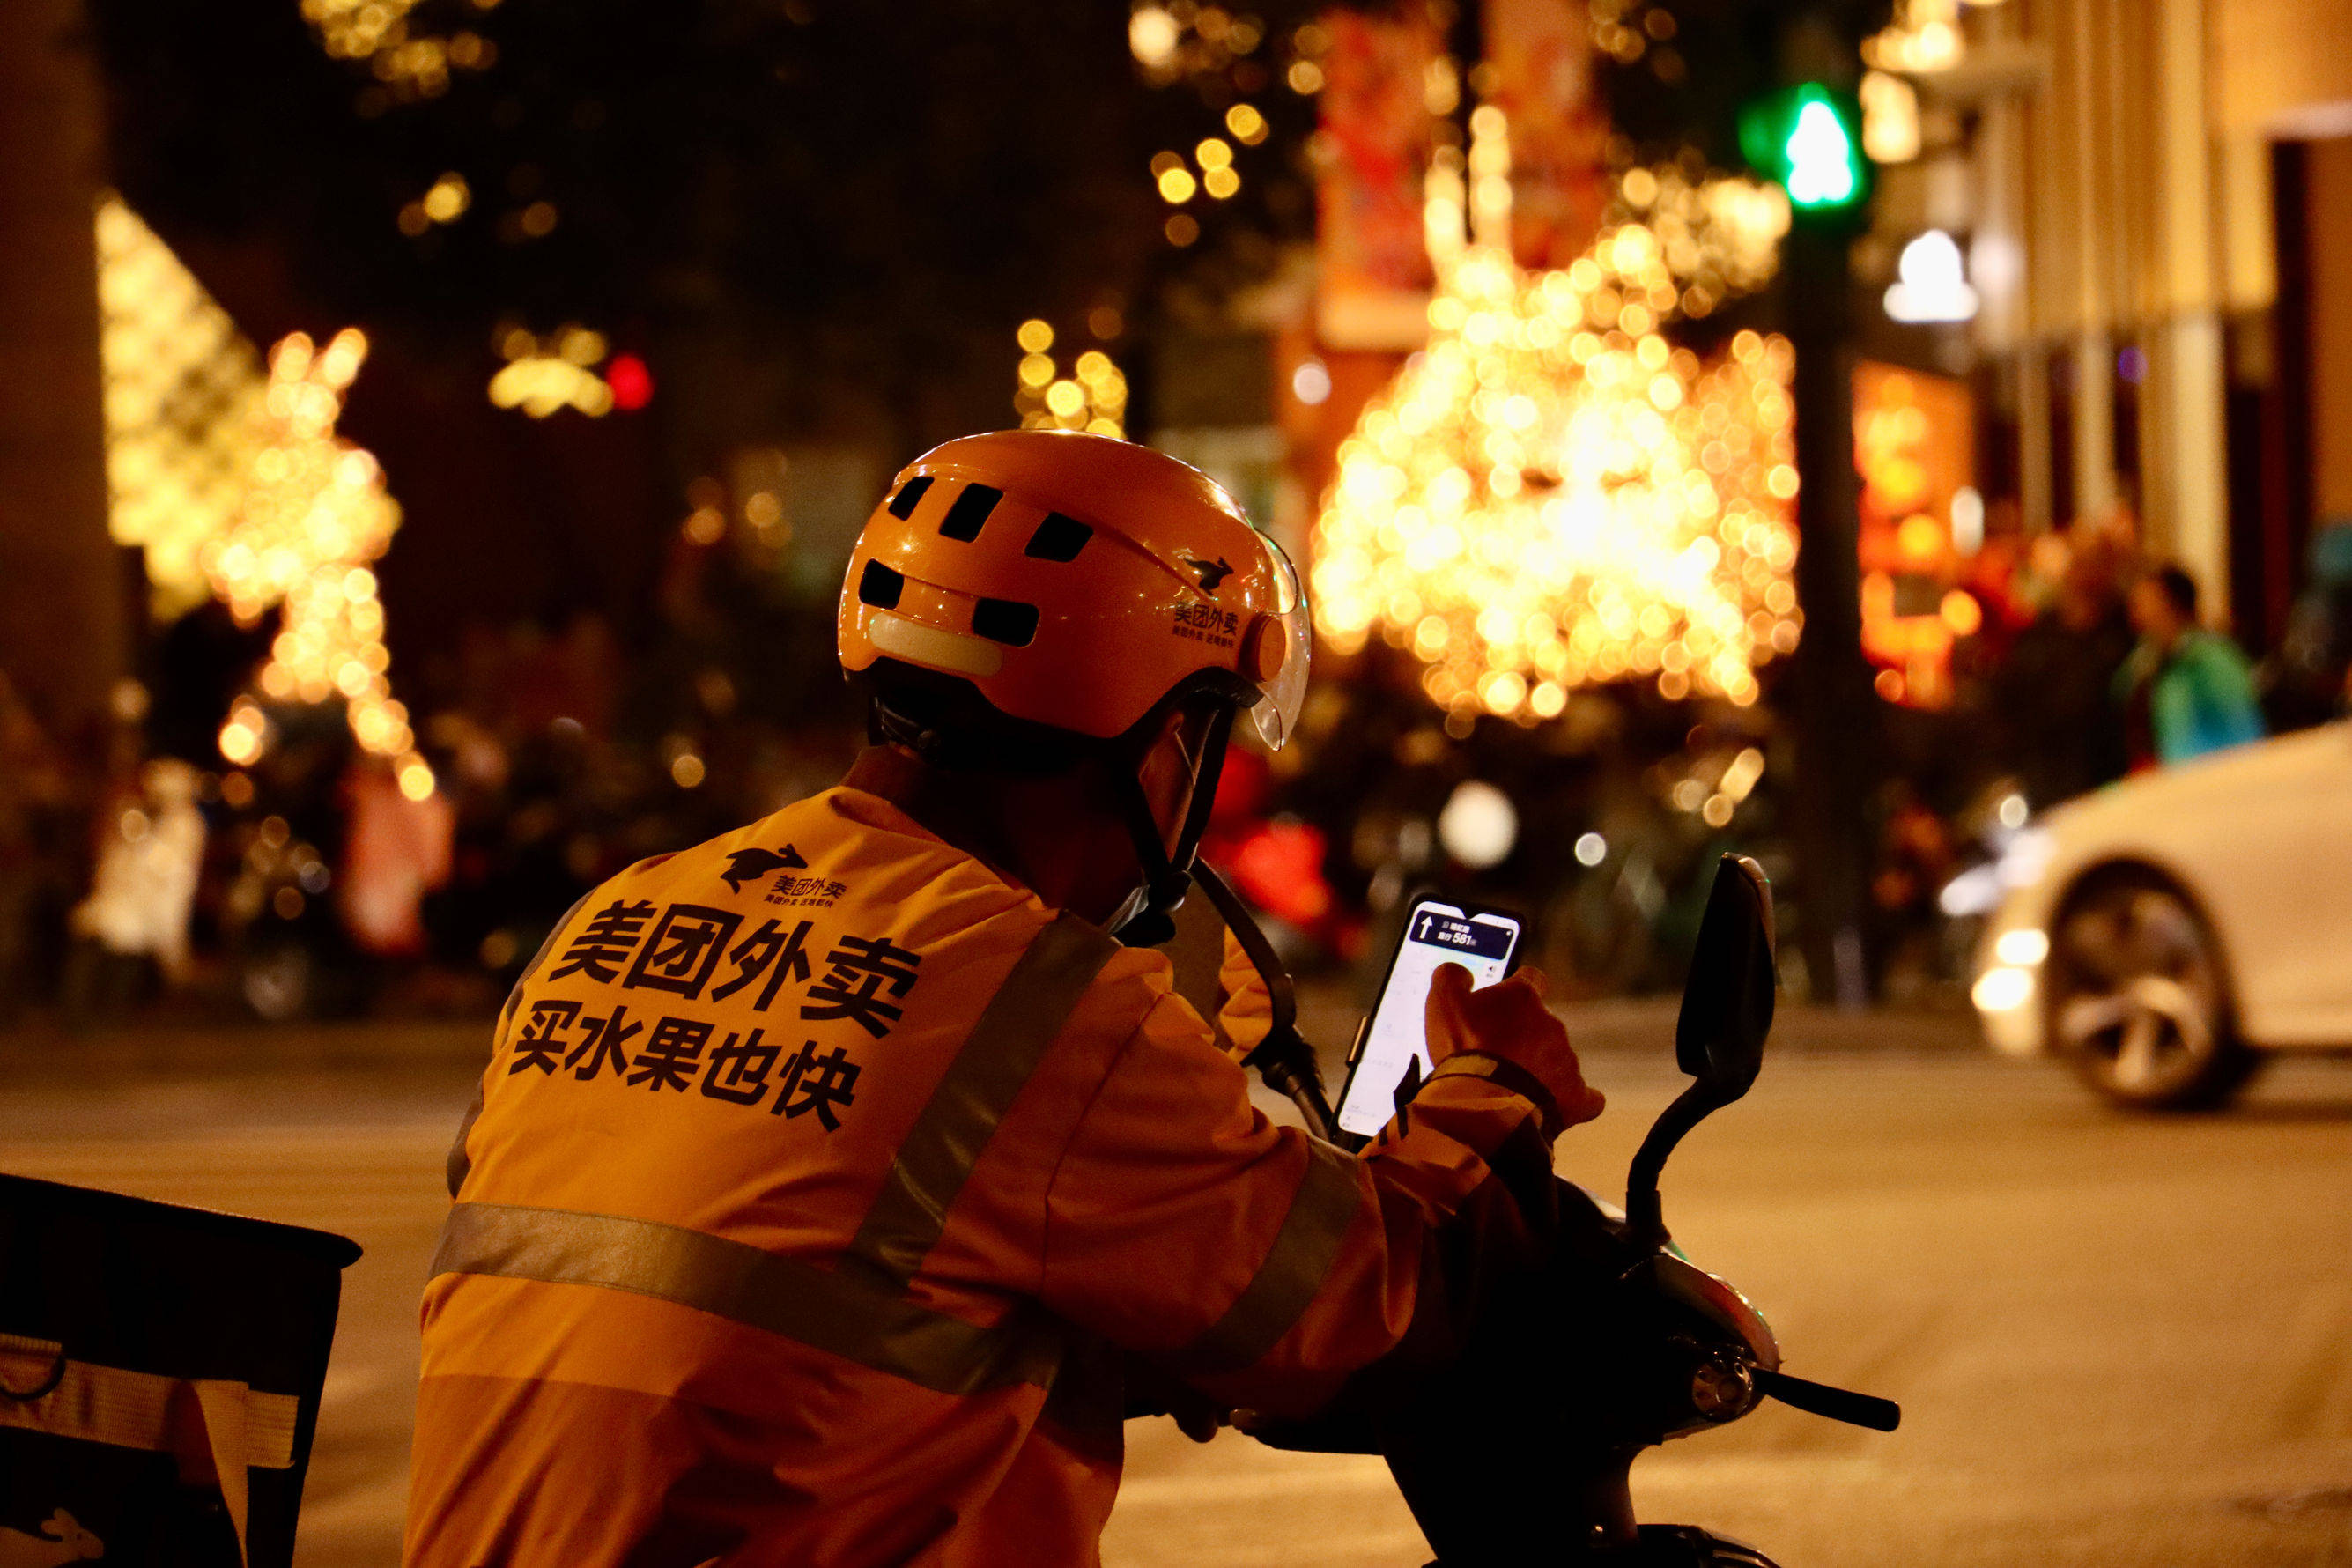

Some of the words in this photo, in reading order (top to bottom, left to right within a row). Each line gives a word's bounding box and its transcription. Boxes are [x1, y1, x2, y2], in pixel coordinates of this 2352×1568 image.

[1174, 601, 1239, 636] 美团外卖
[771, 875, 847, 899] 美团外卖
[549, 899, 921, 1039] 美团外卖
[507, 999, 862, 1133] 买水果也快
